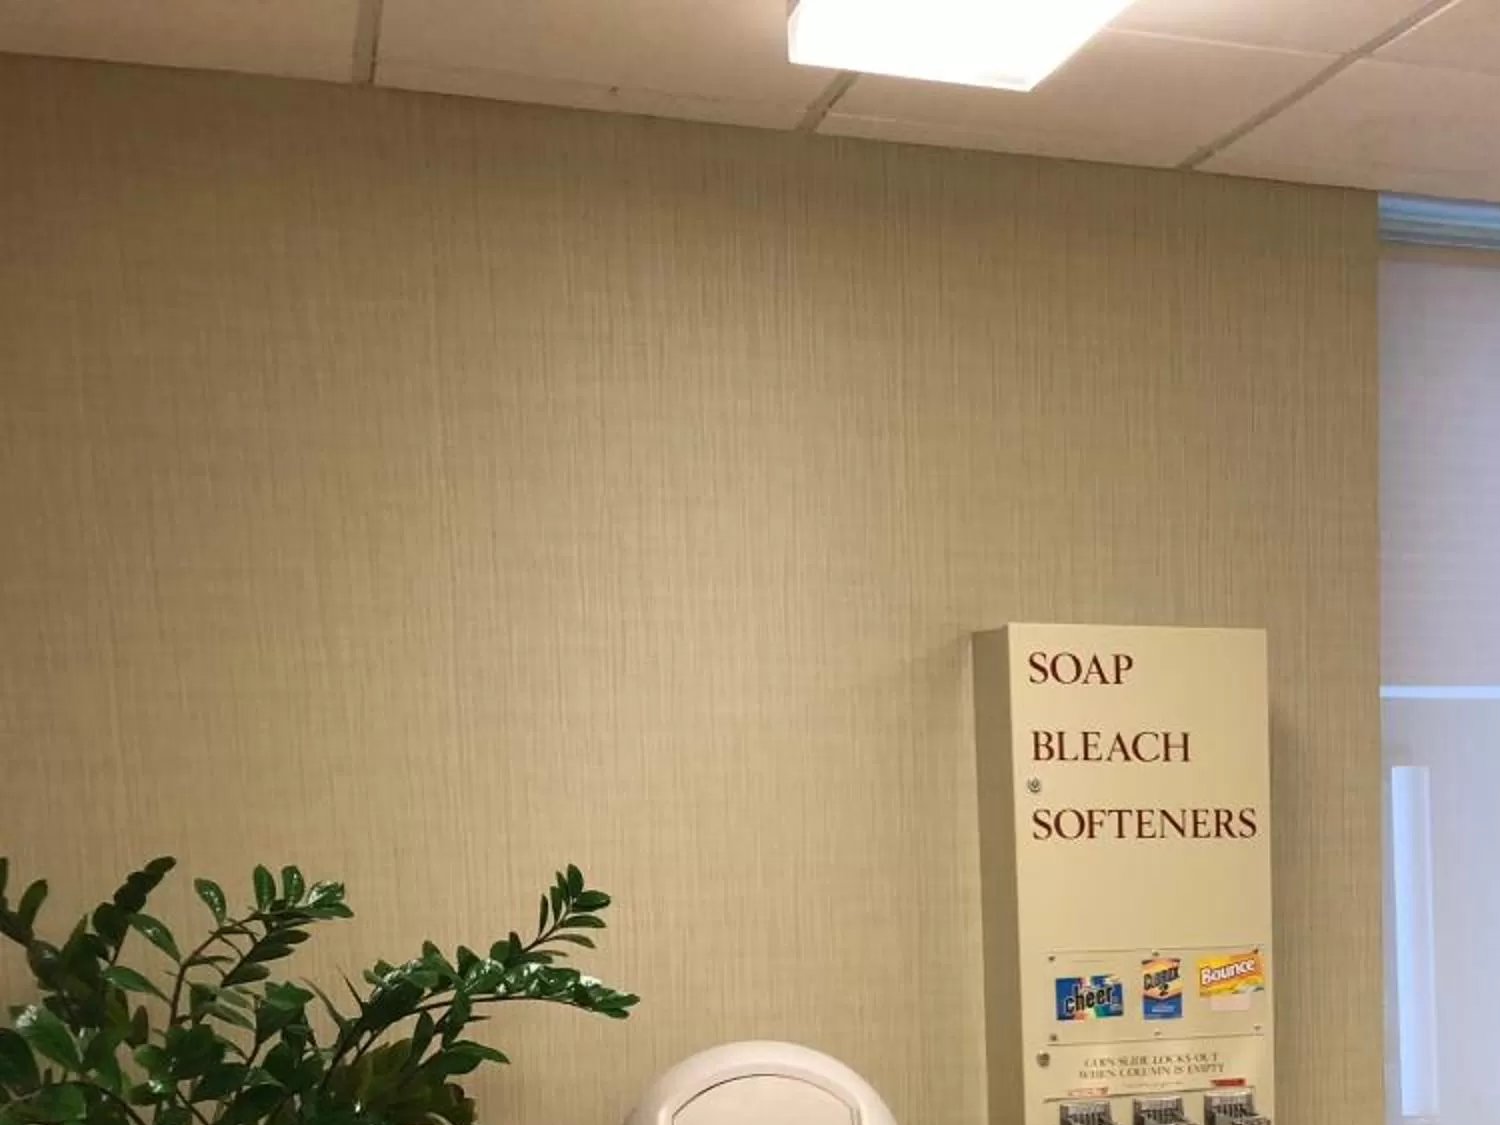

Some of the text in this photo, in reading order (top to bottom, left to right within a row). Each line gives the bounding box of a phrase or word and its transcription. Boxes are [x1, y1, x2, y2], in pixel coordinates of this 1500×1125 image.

[1028, 651, 1133, 685] SOAP
[1031, 730, 1191, 762] BLEACH
[1032, 807, 1257, 840] SOFTENERS
[1200, 958, 1256, 985] Bounce
[1065, 985, 1113, 1013] cheer
